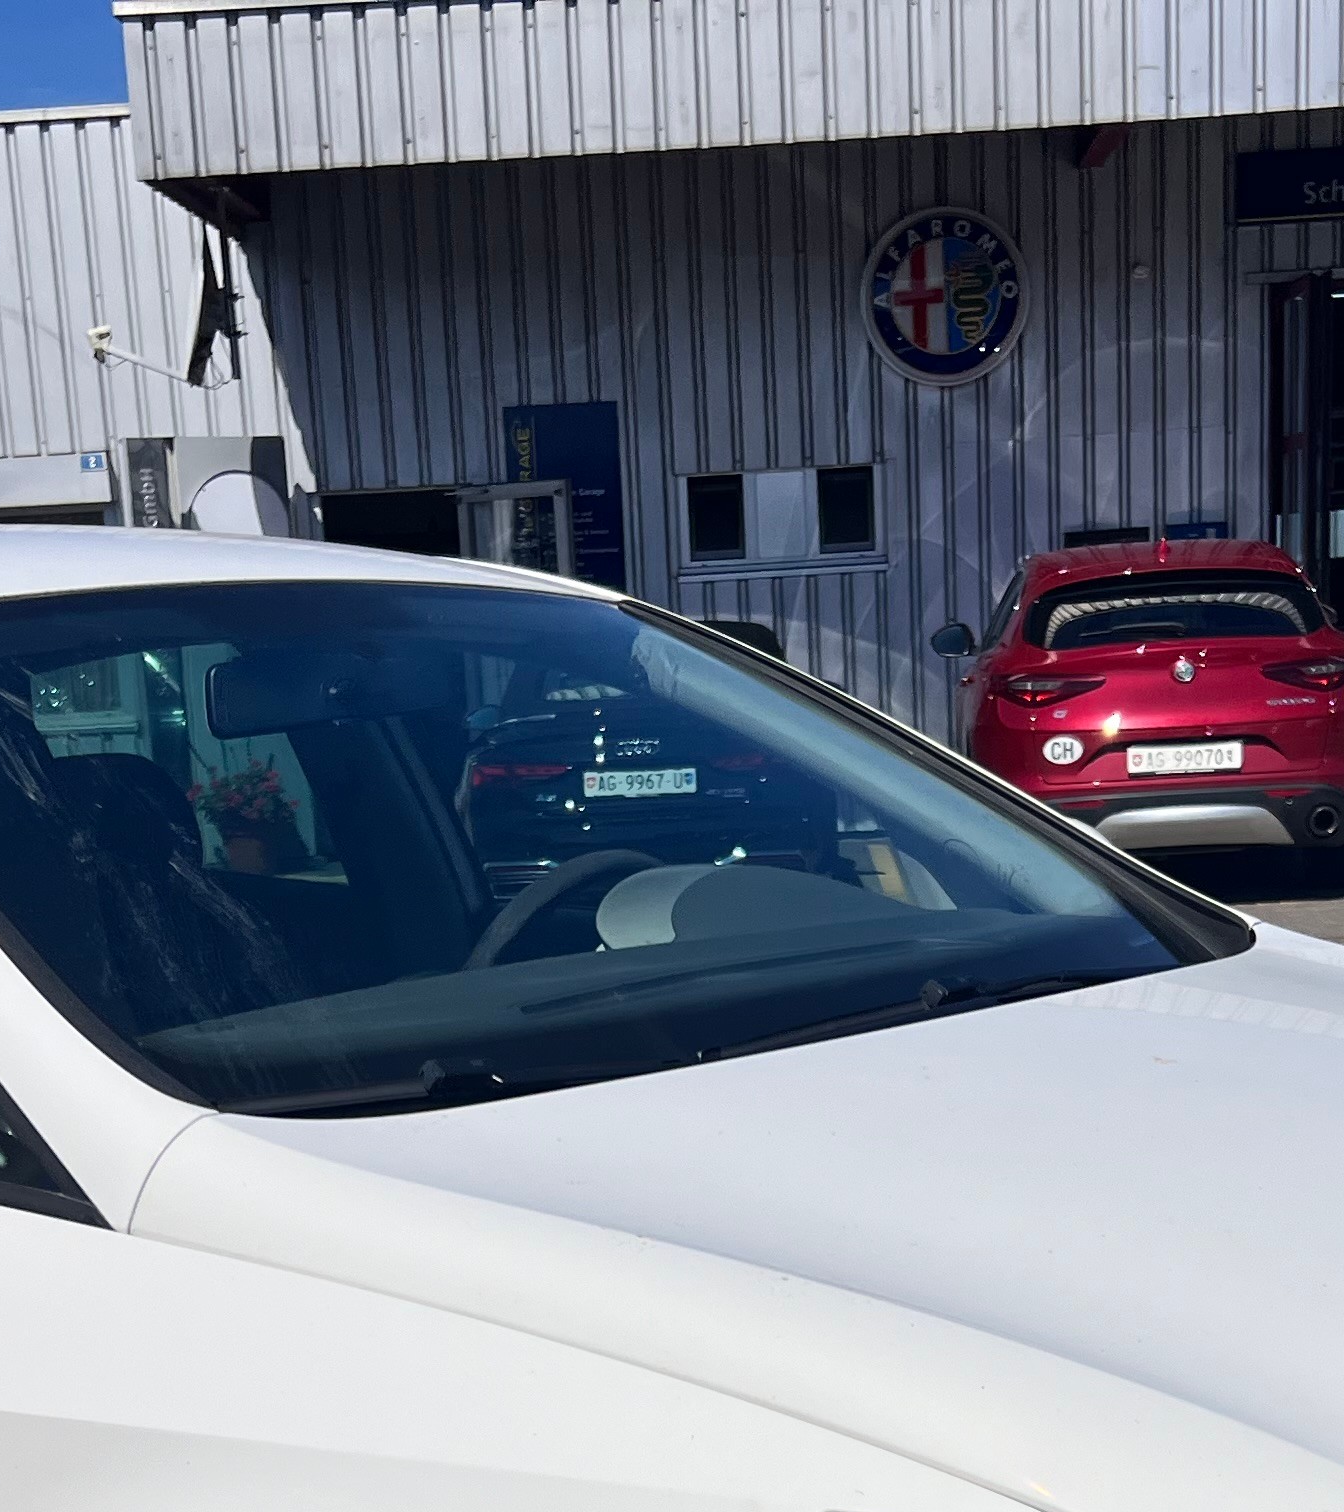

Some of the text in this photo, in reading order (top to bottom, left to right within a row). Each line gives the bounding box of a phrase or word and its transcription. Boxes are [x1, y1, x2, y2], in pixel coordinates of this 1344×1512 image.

[873, 219, 1019, 309] ALFA ROMEO
[89, 456, 97, 468] 2
[1050, 741, 1074, 760] CH
[1147, 748, 1224, 769] AG 99070
